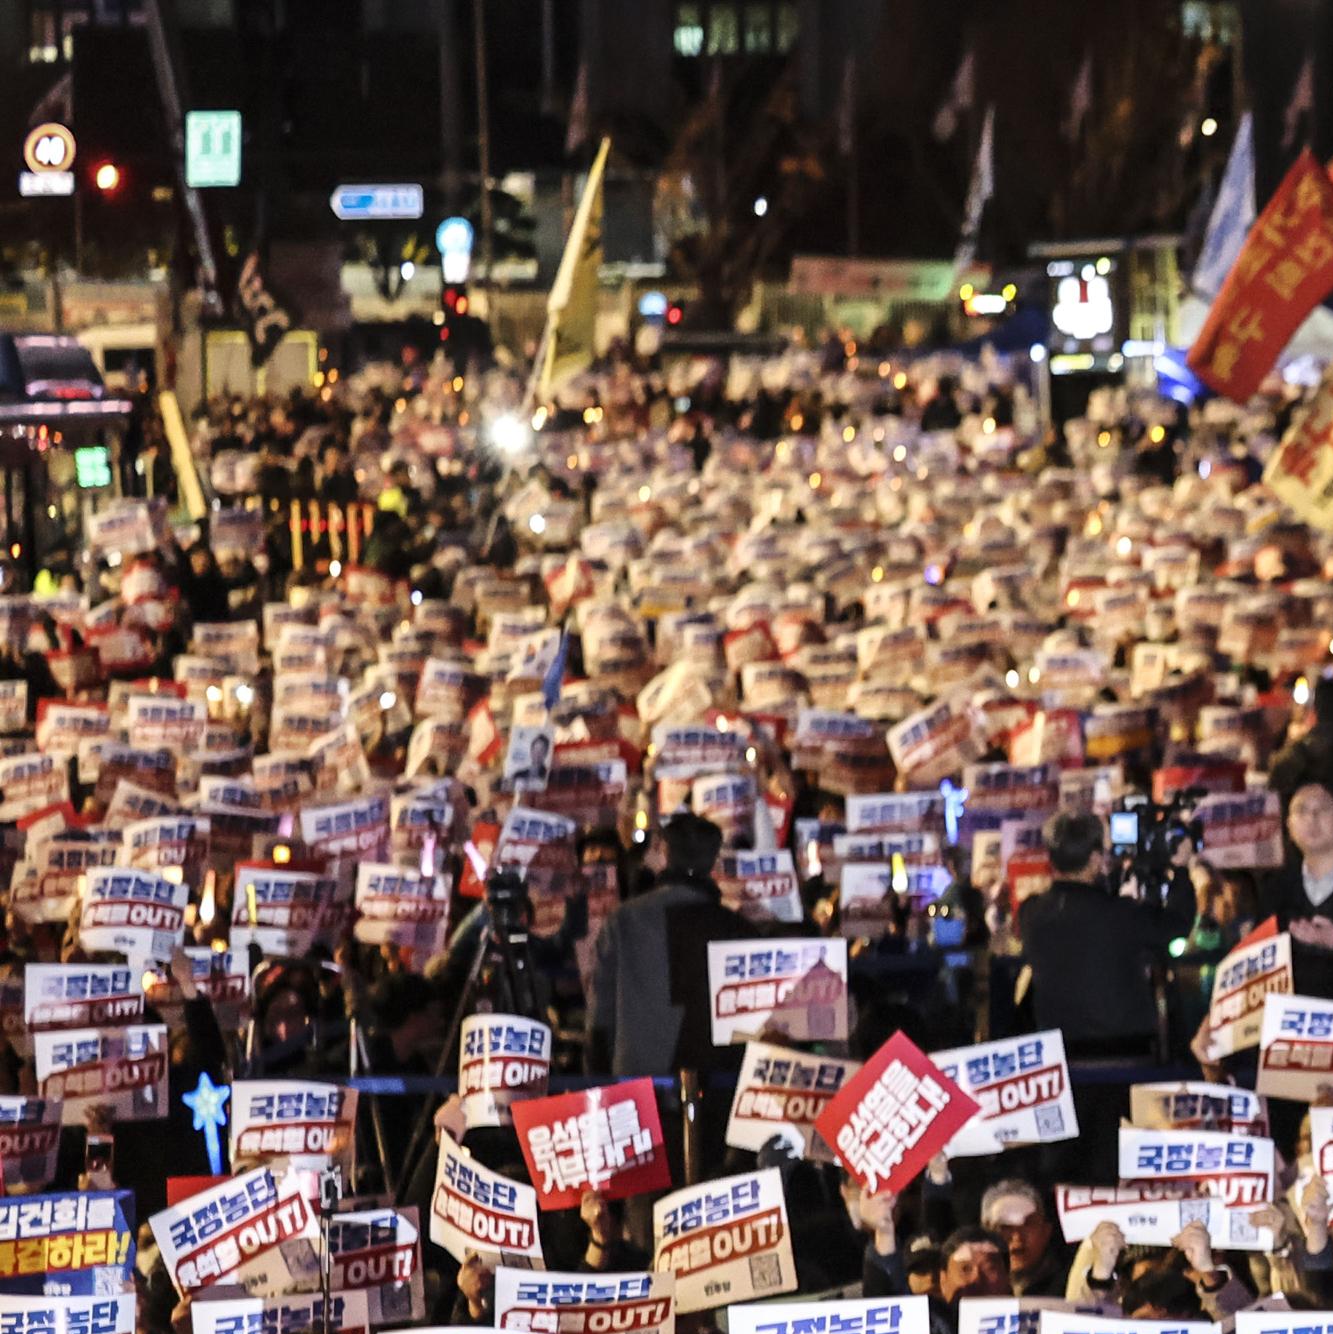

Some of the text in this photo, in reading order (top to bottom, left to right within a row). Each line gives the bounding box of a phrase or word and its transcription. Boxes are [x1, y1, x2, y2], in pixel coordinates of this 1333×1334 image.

[1219, 943, 1277, 991] 국정농단
[753, 1058, 846, 1090] 국정농단
[1000, 1067, 1062, 1108] OUT!
[251, 1091, 338, 1120] 국정농단
[838, 1059, 918, 1159] 윤석열을
[858, 1074, 951, 1193] 거부한다!
[1138, 1142, 1255, 1173] 국정농단
[444, 1154, 518, 1211] 국정농단
[169, 1173, 278, 1252] 국정농단
[663, 1180, 761, 1240] 국정농단
[713, 1210, 781, 1260] OUT!
[516, 1277, 651, 1303] 국정농단
[588, 1299, 669, 1333] OUT!
